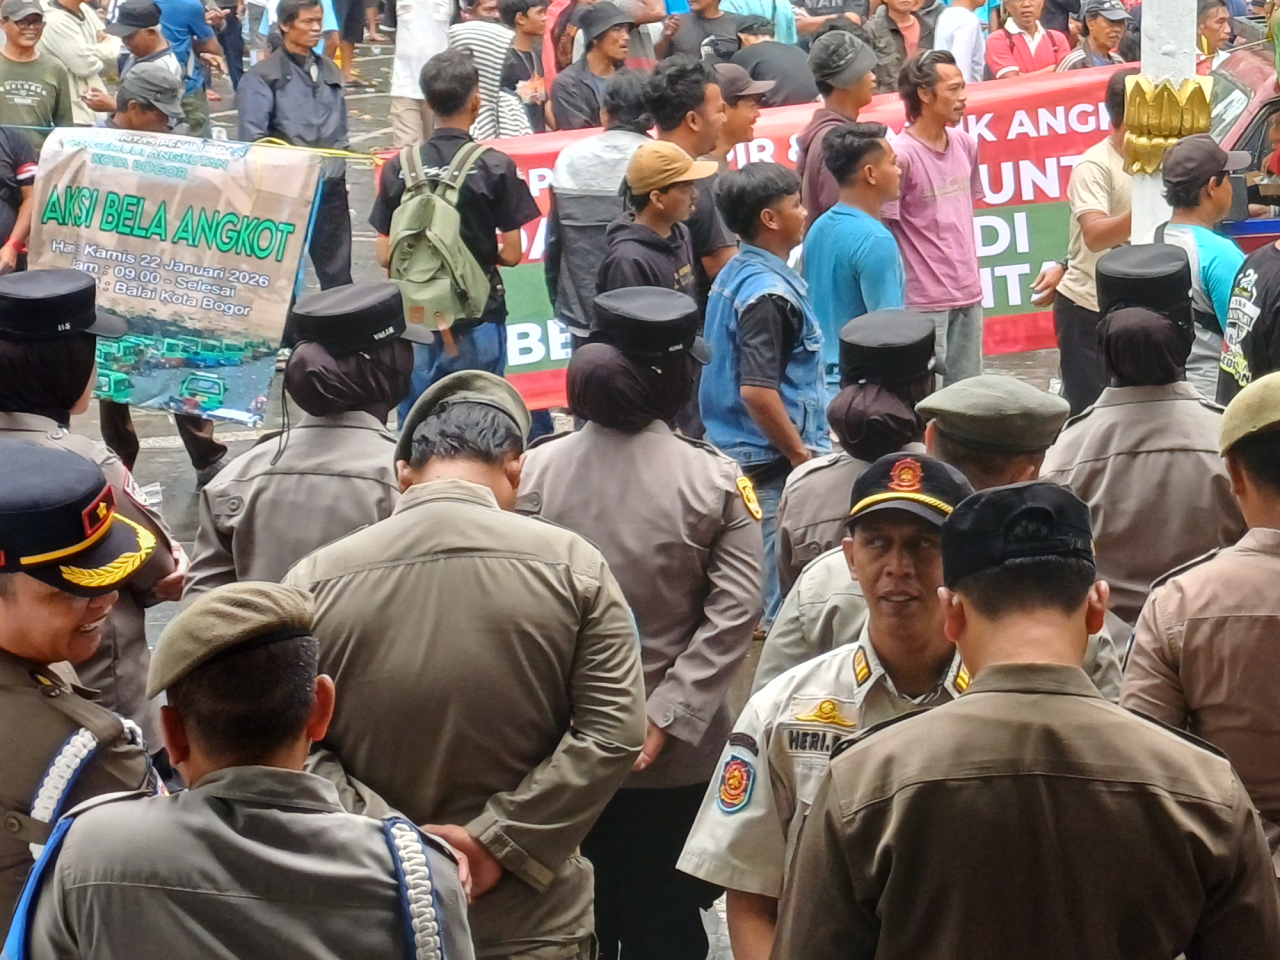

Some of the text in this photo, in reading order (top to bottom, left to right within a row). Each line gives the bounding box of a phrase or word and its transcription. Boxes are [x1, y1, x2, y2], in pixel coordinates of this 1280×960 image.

[92, 152, 188, 180] KOTA BOGOR
[147, 148, 229, 170] ANGKUTAN
[40, 184, 295, 262] AKSI BELA ANGKOT
[70, 258, 99, 274] Jam
[113, 265, 160, 284] 09.00
[175, 276, 236, 298] Selesai
[84, 243, 136, 264] Kamis
[139, 254, 161, 268] 22
[164, 259, 225, 279] Januari
[228, 269, 270, 287] 2026
[114, 280, 156, 300] Balai
[160, 289, 197, 307] Kota
[201, 297, 252, 316] Bogor
